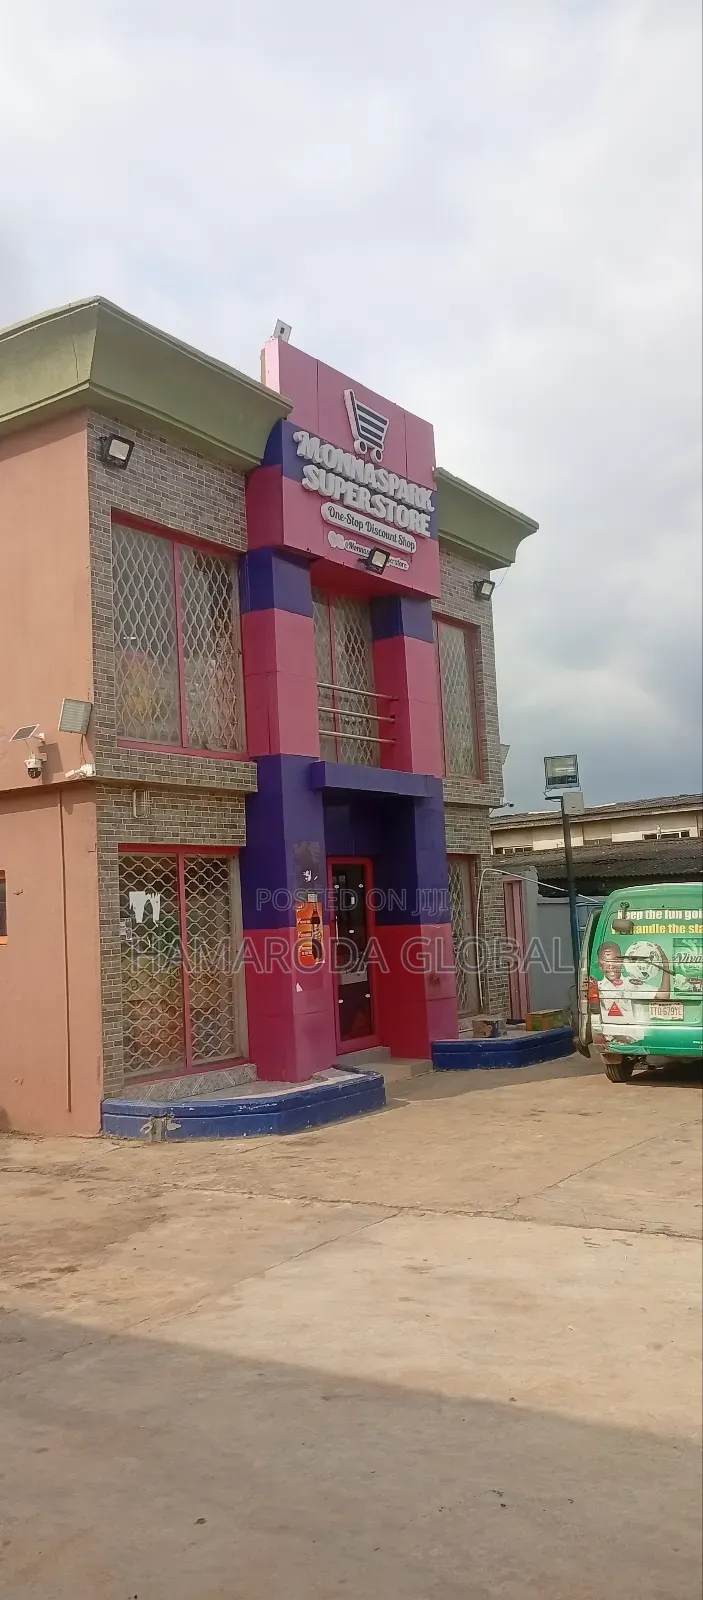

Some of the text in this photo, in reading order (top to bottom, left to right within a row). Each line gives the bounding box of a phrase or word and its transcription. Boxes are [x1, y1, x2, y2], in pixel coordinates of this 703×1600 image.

[293, 431, 435, 512] MONNASPARK
[302, 465, 431, 538] SUPERSTORE
[327, 505, 415, 553] One-Stop Discount Shop
[645, 909, 663, 919] the
[668, 923, 686, 934] the
